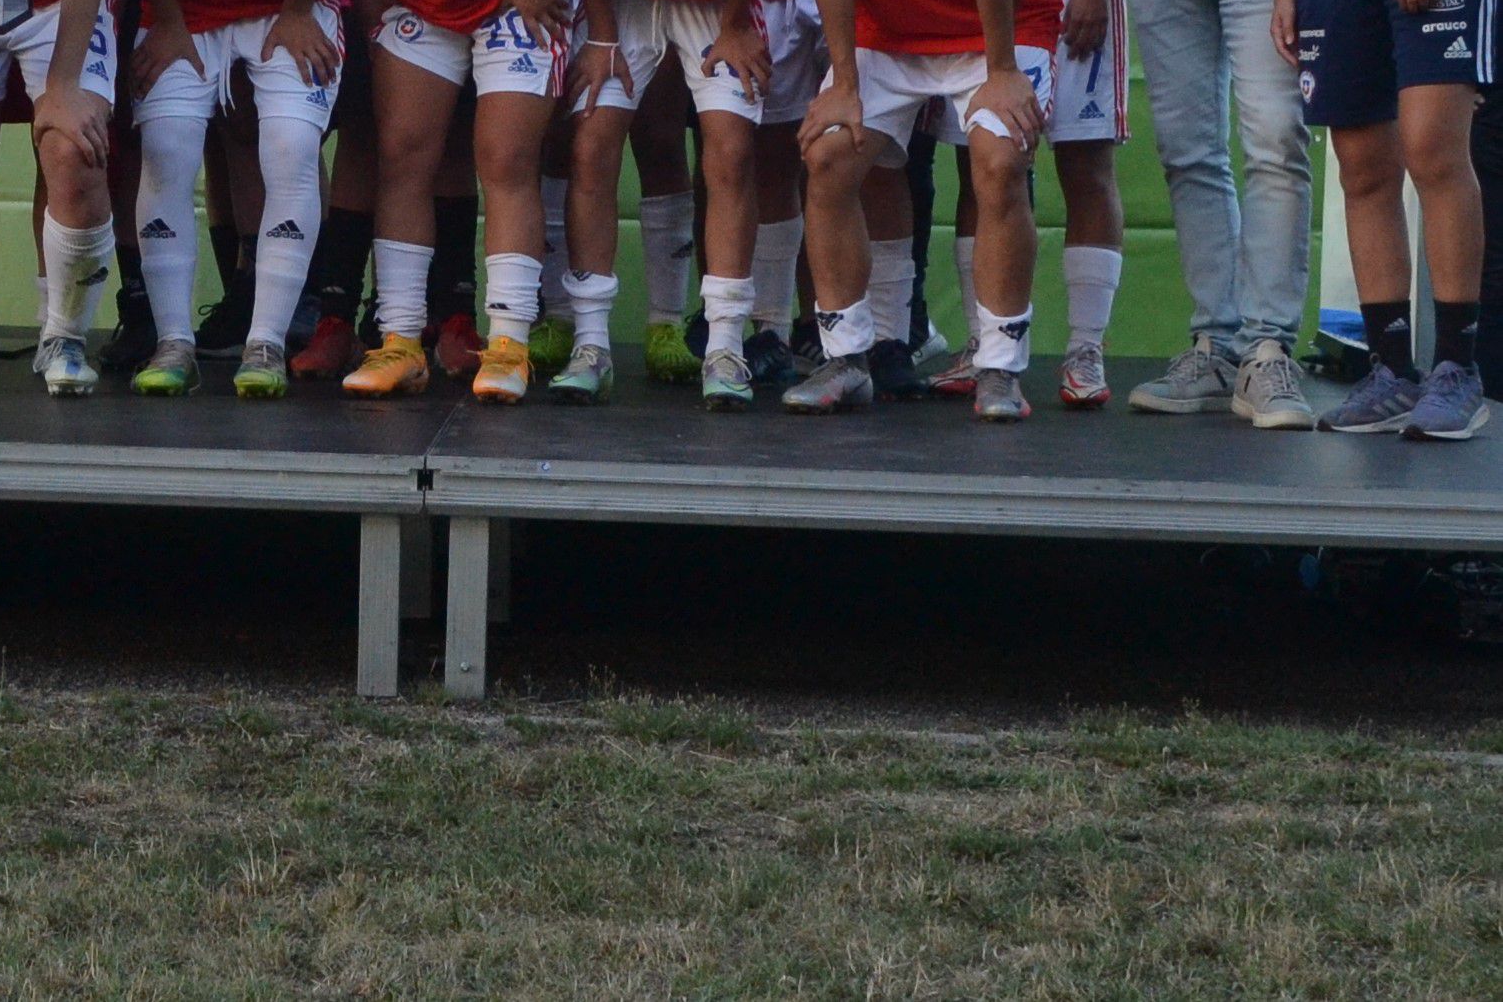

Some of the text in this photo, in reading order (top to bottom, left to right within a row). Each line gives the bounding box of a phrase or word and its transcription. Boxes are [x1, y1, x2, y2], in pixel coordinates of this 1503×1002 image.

[1422, 21, 1467, 33] arauco
[504, 65, 534, 73] adidas
[139, 231, 173, 239] adidas
[266, 231, 301, 240] adidas
